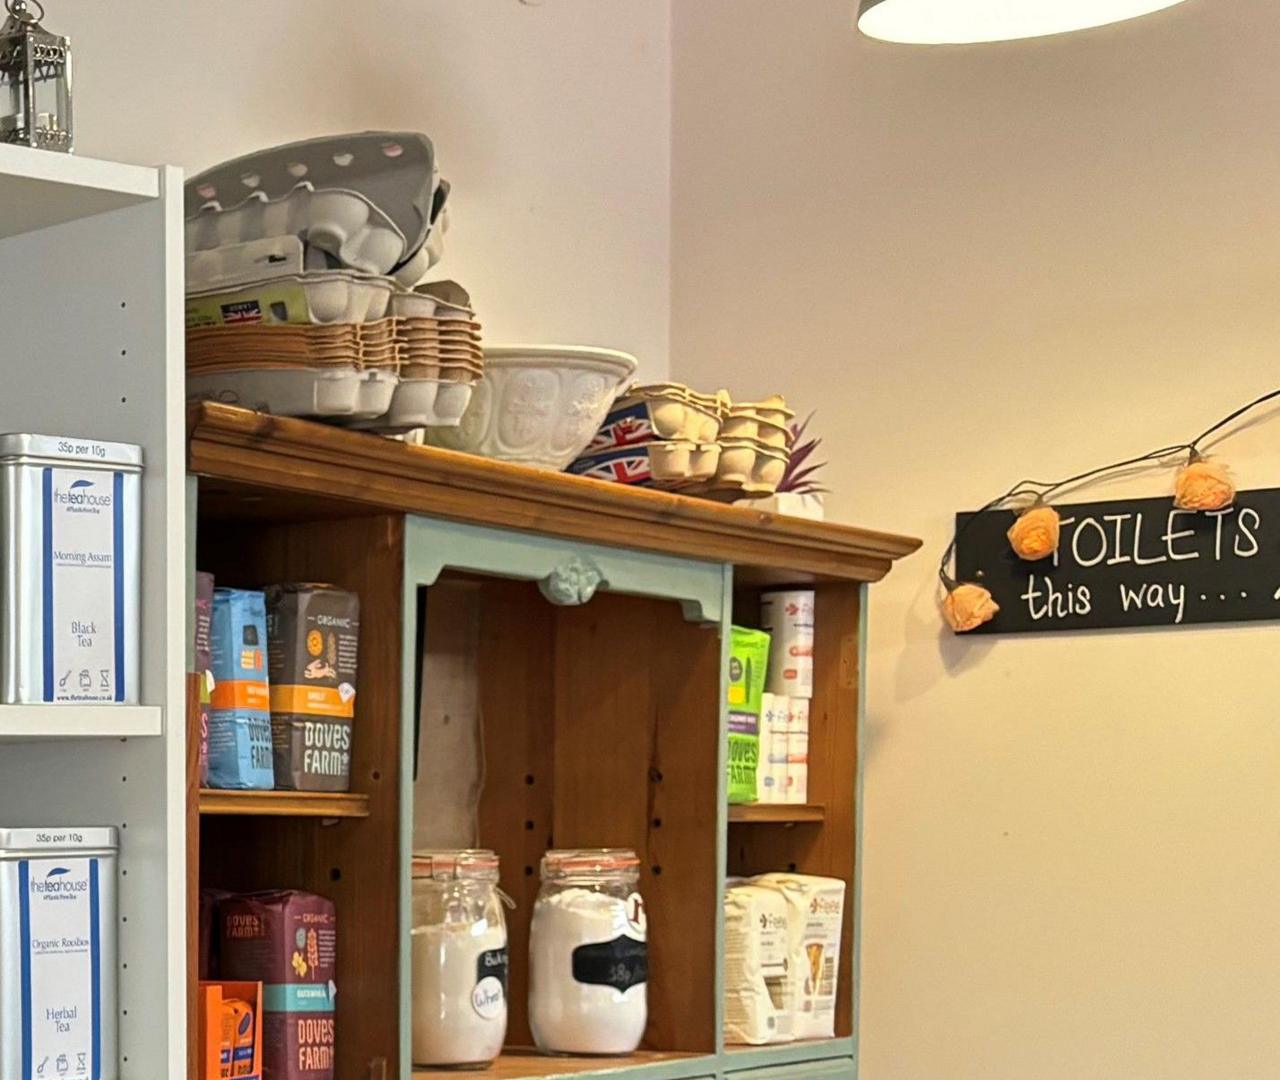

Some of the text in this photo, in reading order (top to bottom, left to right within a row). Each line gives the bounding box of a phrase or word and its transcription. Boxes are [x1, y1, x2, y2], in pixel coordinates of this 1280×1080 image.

[54, 488, 112, 506] theteahouse
[53, 551, 87, 564] Morning
[1020, 574, 1092, 621] this
[71, 621, 97, 634] Black
[77, 634, 93, 648] Tea
[53, 834, 67, 844] per
[68, 832, 83, 844] 10g
[31, 878, 89, 893] theteahouse
[32, 938, 60, 950] Organic
[46, 1006, 78, 1021] Herbal
[55, 1020, 71, 1033] Tea
